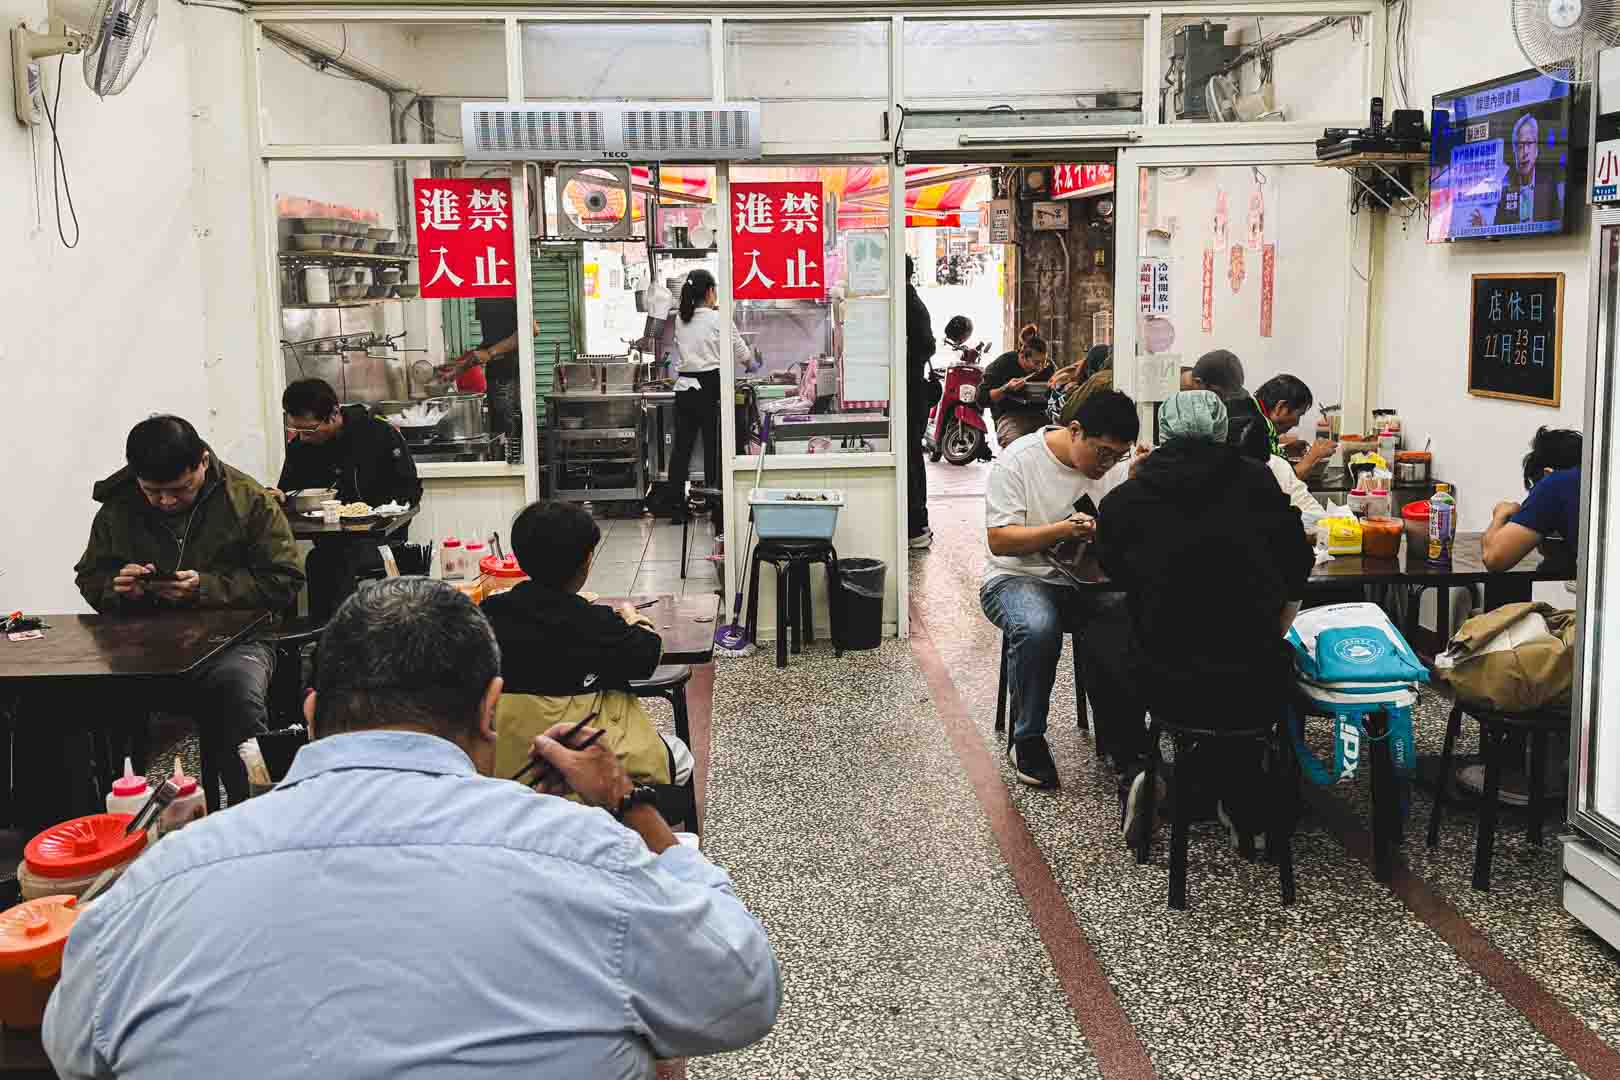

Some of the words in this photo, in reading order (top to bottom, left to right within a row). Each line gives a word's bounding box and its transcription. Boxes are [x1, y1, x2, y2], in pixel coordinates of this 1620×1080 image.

[1598, 150, 1618, 185] 小
[419, 188, 465, 288] 進入
[466, 188, 512, 287] 禁止
[735, 191, 776, 288] 進入
[780, 191, 821, 288] 禁止
[1158, 262, 1169, 313] 冷氣開放中
[1488, 289, 1543, 322] 店休日
[1483, 334, 1512, 363] 11月
[1515, 328, 1529, 346] 13
[1532, 335, 1545, 367] 日
[1514, 350, 1528, 366] 26
